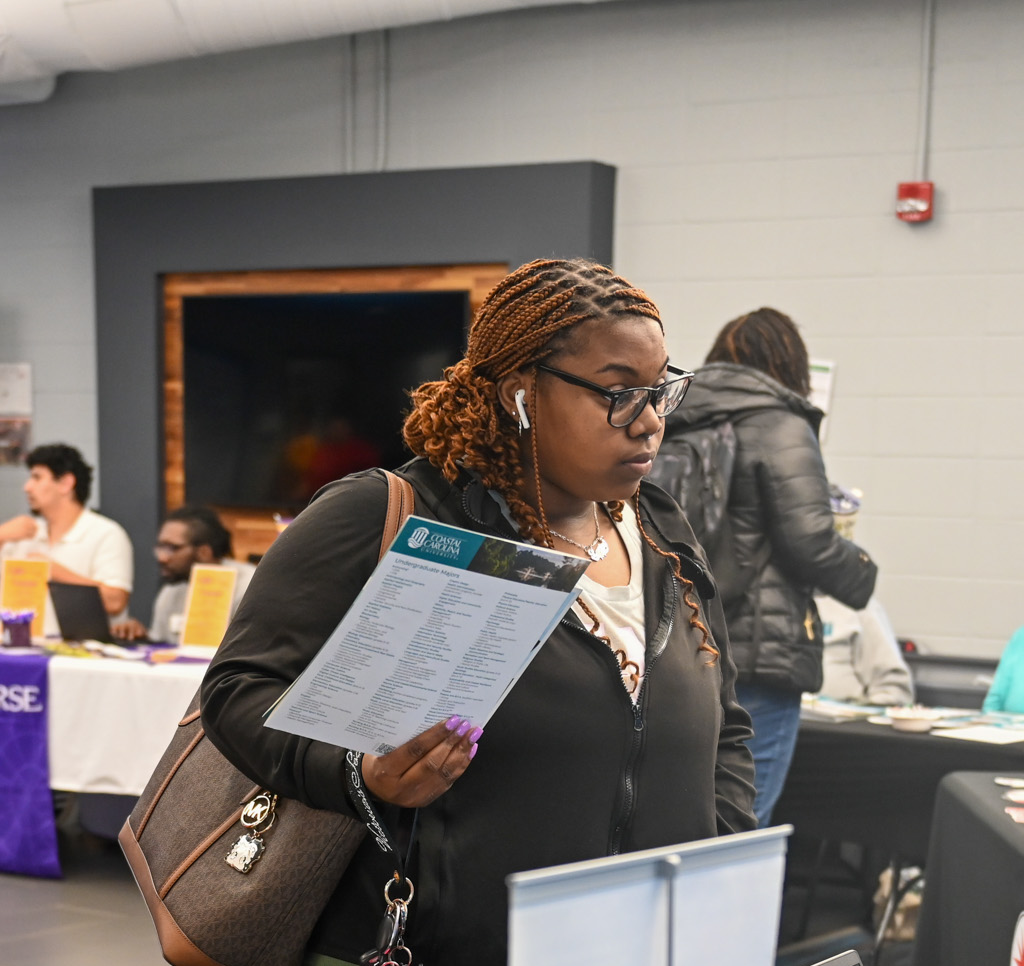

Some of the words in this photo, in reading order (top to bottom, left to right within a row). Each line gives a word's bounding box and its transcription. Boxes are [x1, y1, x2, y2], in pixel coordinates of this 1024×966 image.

[424, 540, 460, 555] CAROLINA
[431, 534, 461, 548] COASTAL
[394, 557, 440, 574] Undergraduate
[441, 569, 460, 579] Majors
[244, 800, 269, 821] MK
